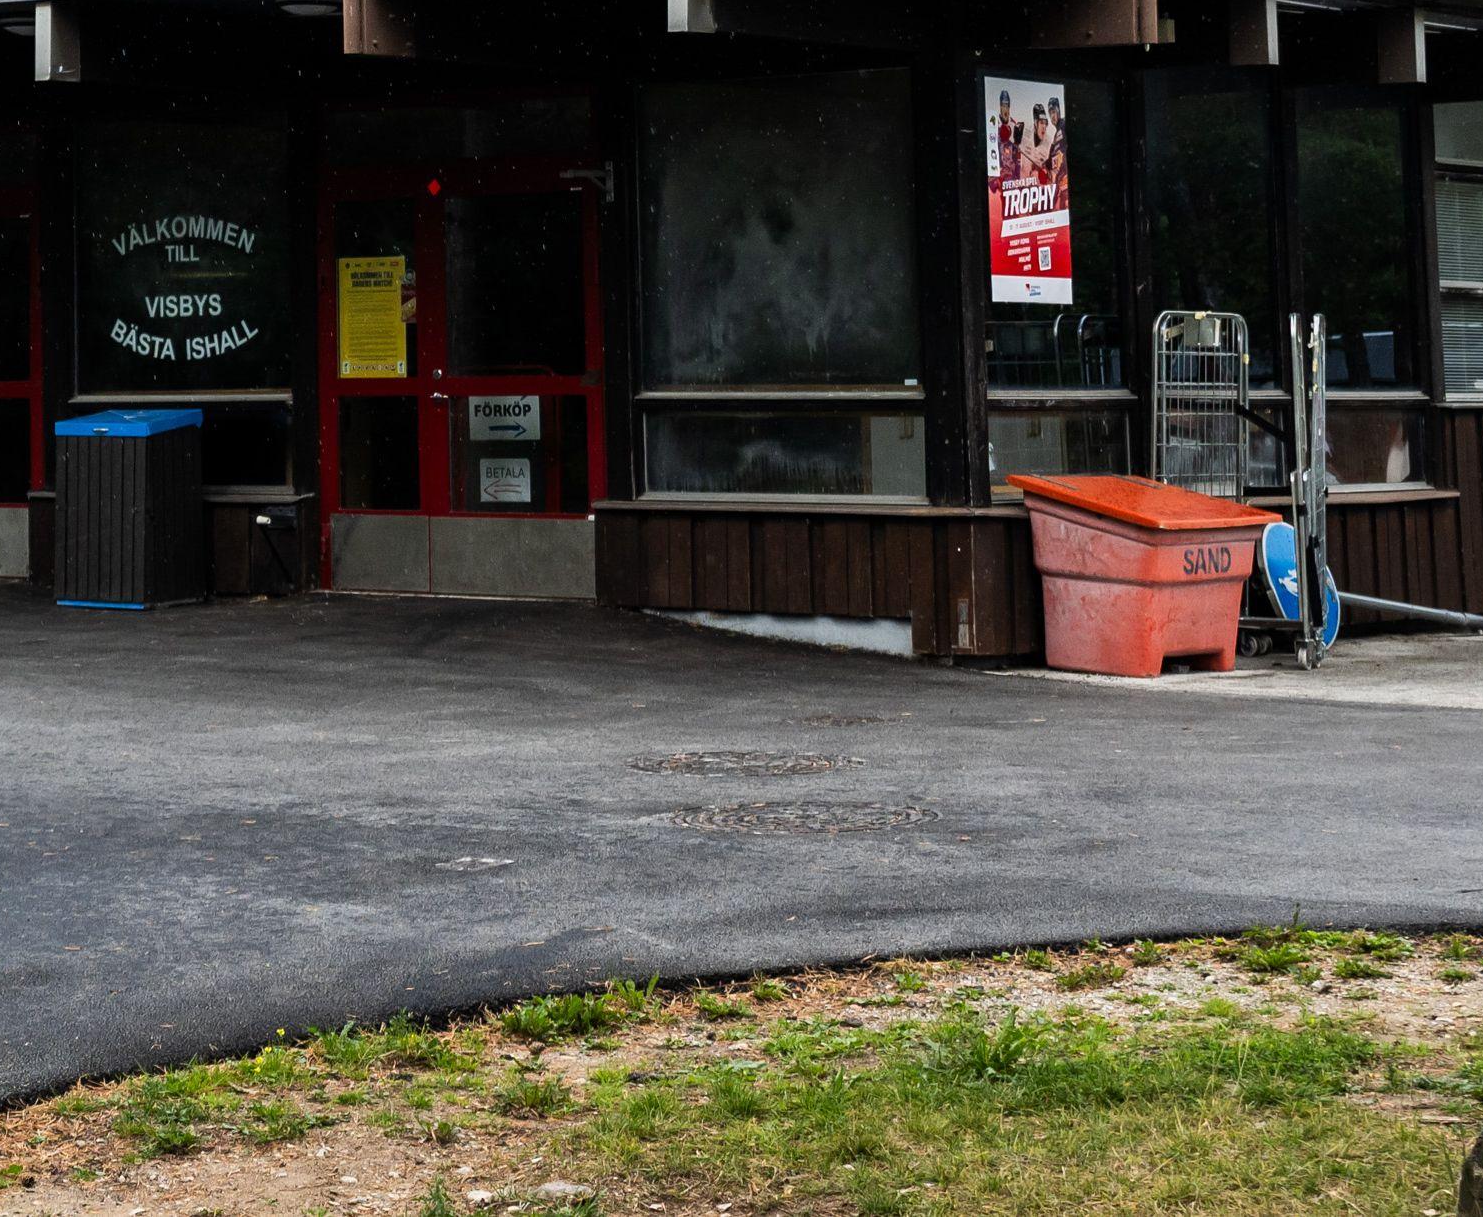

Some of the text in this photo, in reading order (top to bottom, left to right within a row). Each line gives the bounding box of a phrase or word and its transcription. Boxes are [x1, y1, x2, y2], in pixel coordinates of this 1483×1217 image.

[1002, 183, 1057, 217] TROPHY
[111, 215, 255, 256] VÄLKOMMEN
[165, 244, 199, 262] TILL
[145, 293, 222, 318] VISBYS
[110, 318, 259, 361] BÄSTA ISHALL
[474, 400, 532, 418] FÖRKÖP
[485, 467, 526, 479] BETALA
[1183, 547, 1232, 575] SAND
